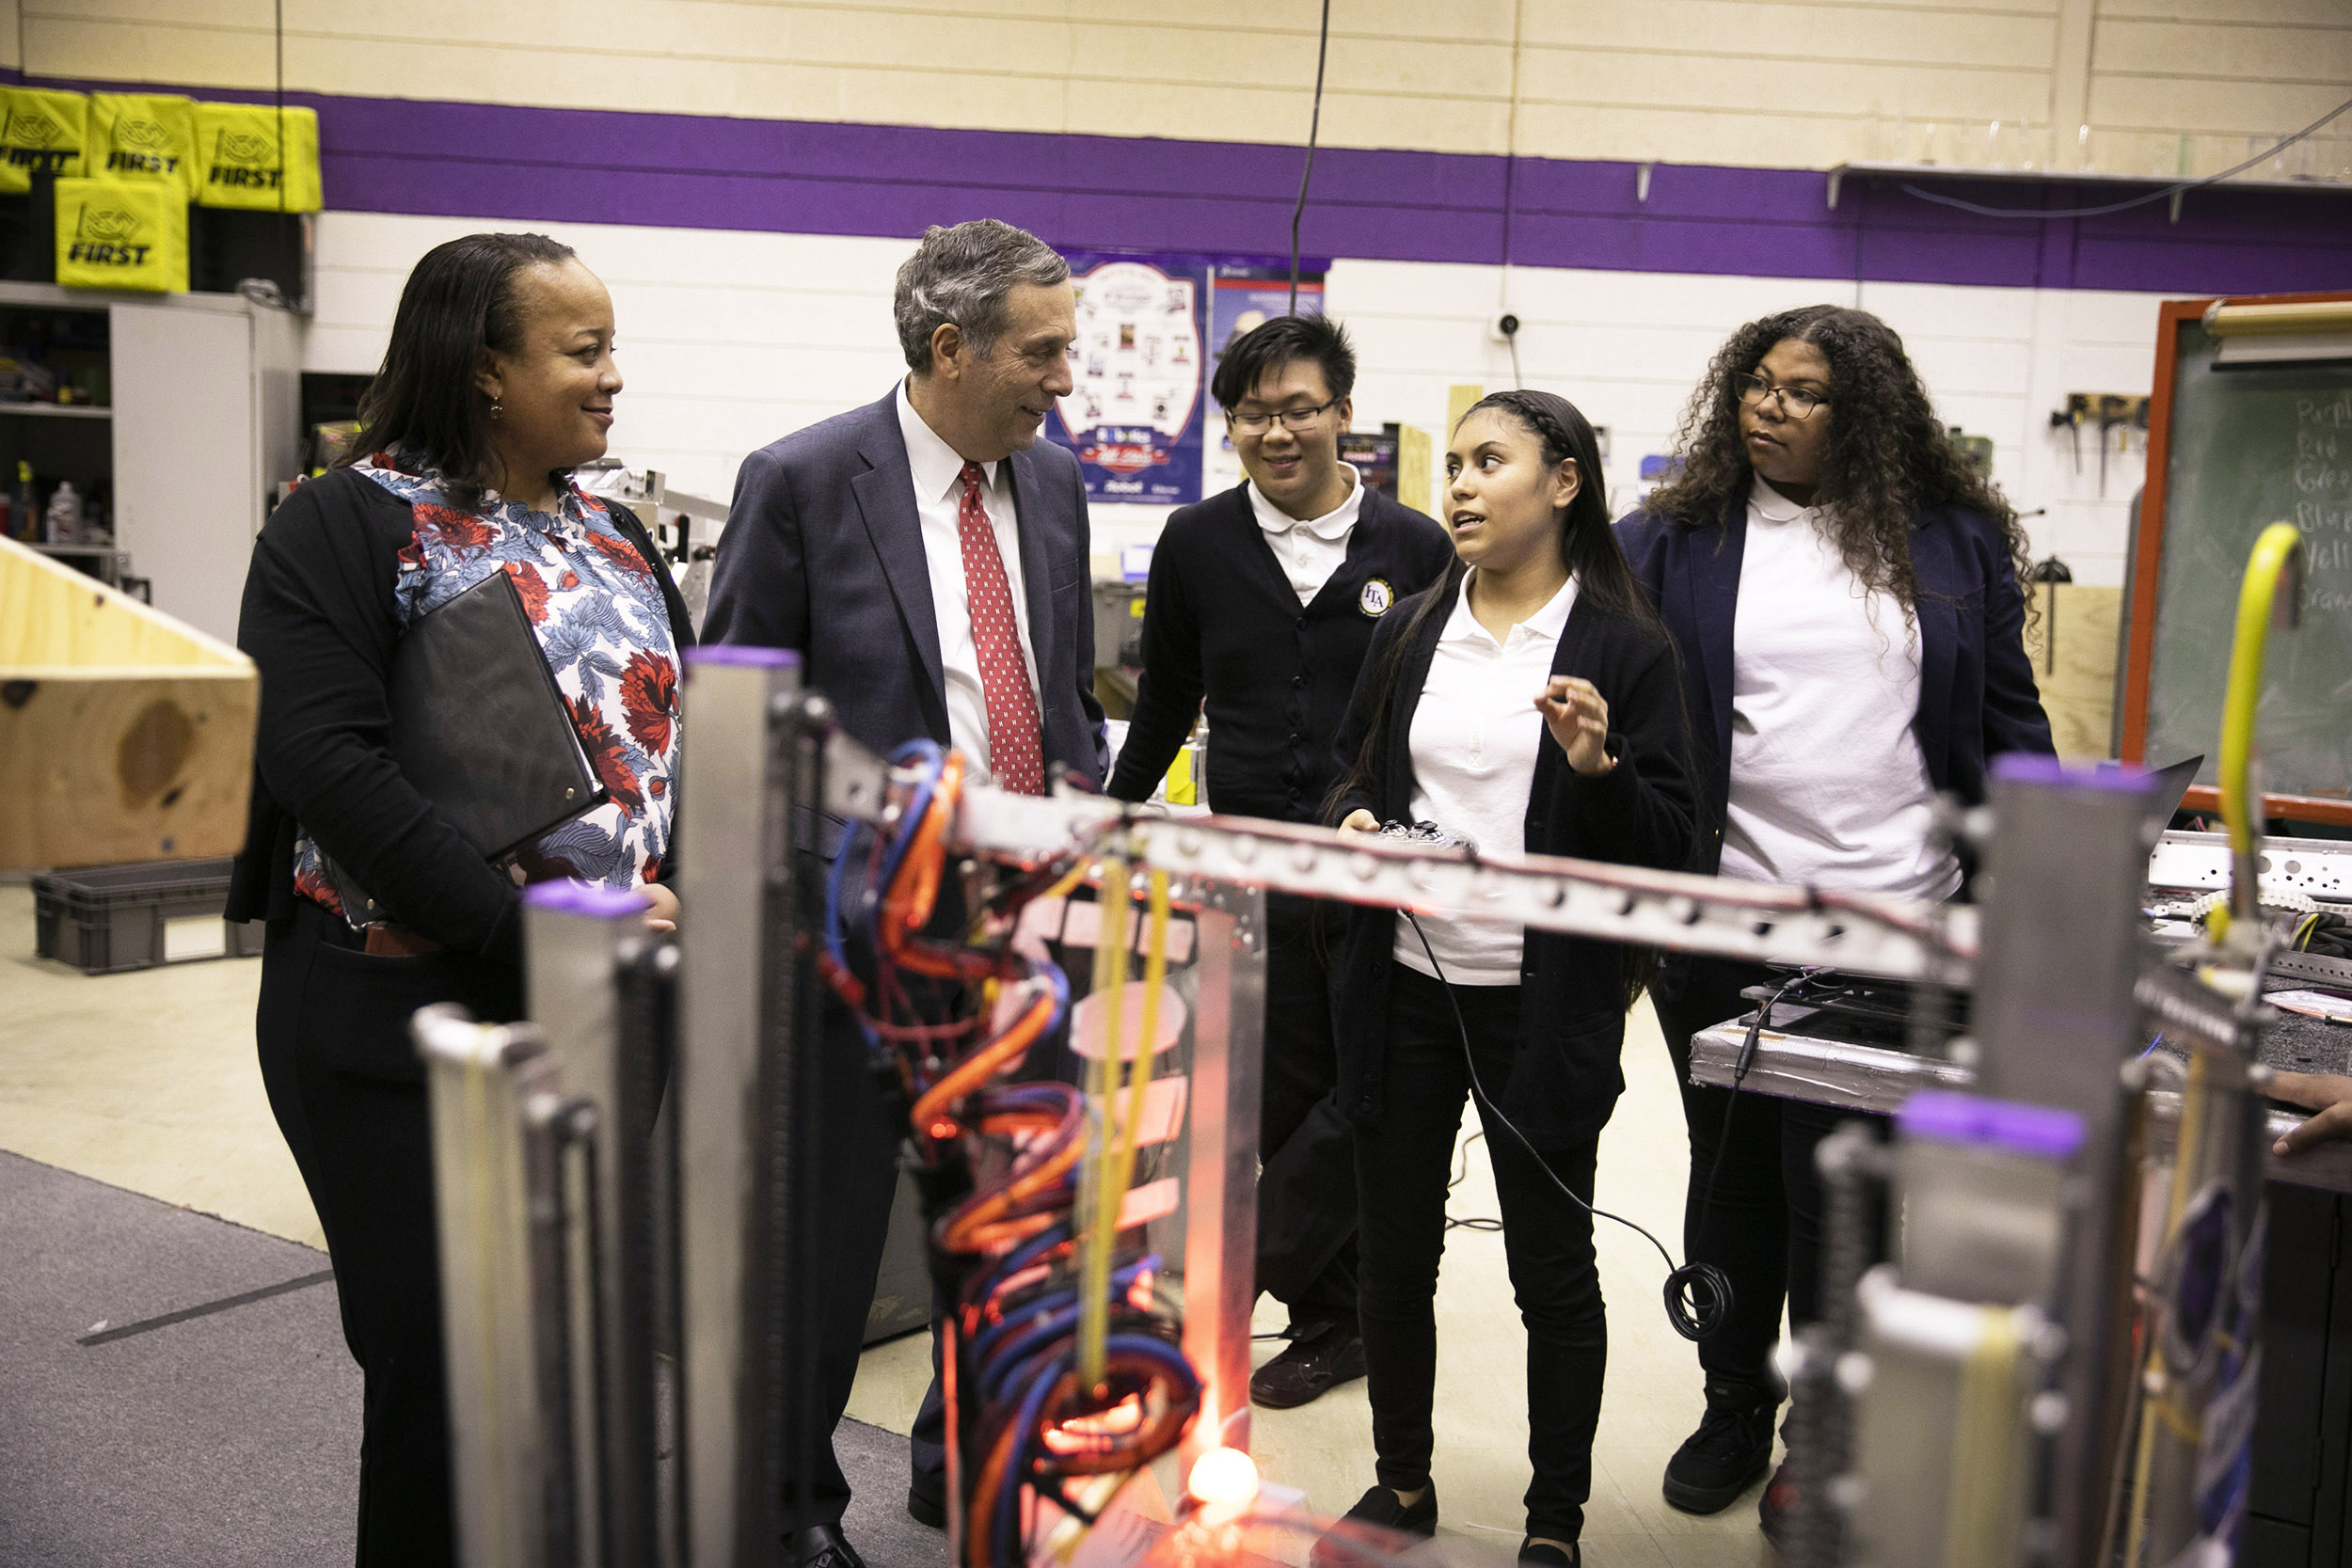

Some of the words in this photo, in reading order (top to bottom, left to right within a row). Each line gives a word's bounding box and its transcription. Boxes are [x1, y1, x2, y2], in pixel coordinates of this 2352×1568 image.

[106, 150, 179, 173] FIRST
[209, 166, 281, 187] FIRST
[69, 241, 151, 266] FIRST
[1365, 584, 1384, 609] ITA
